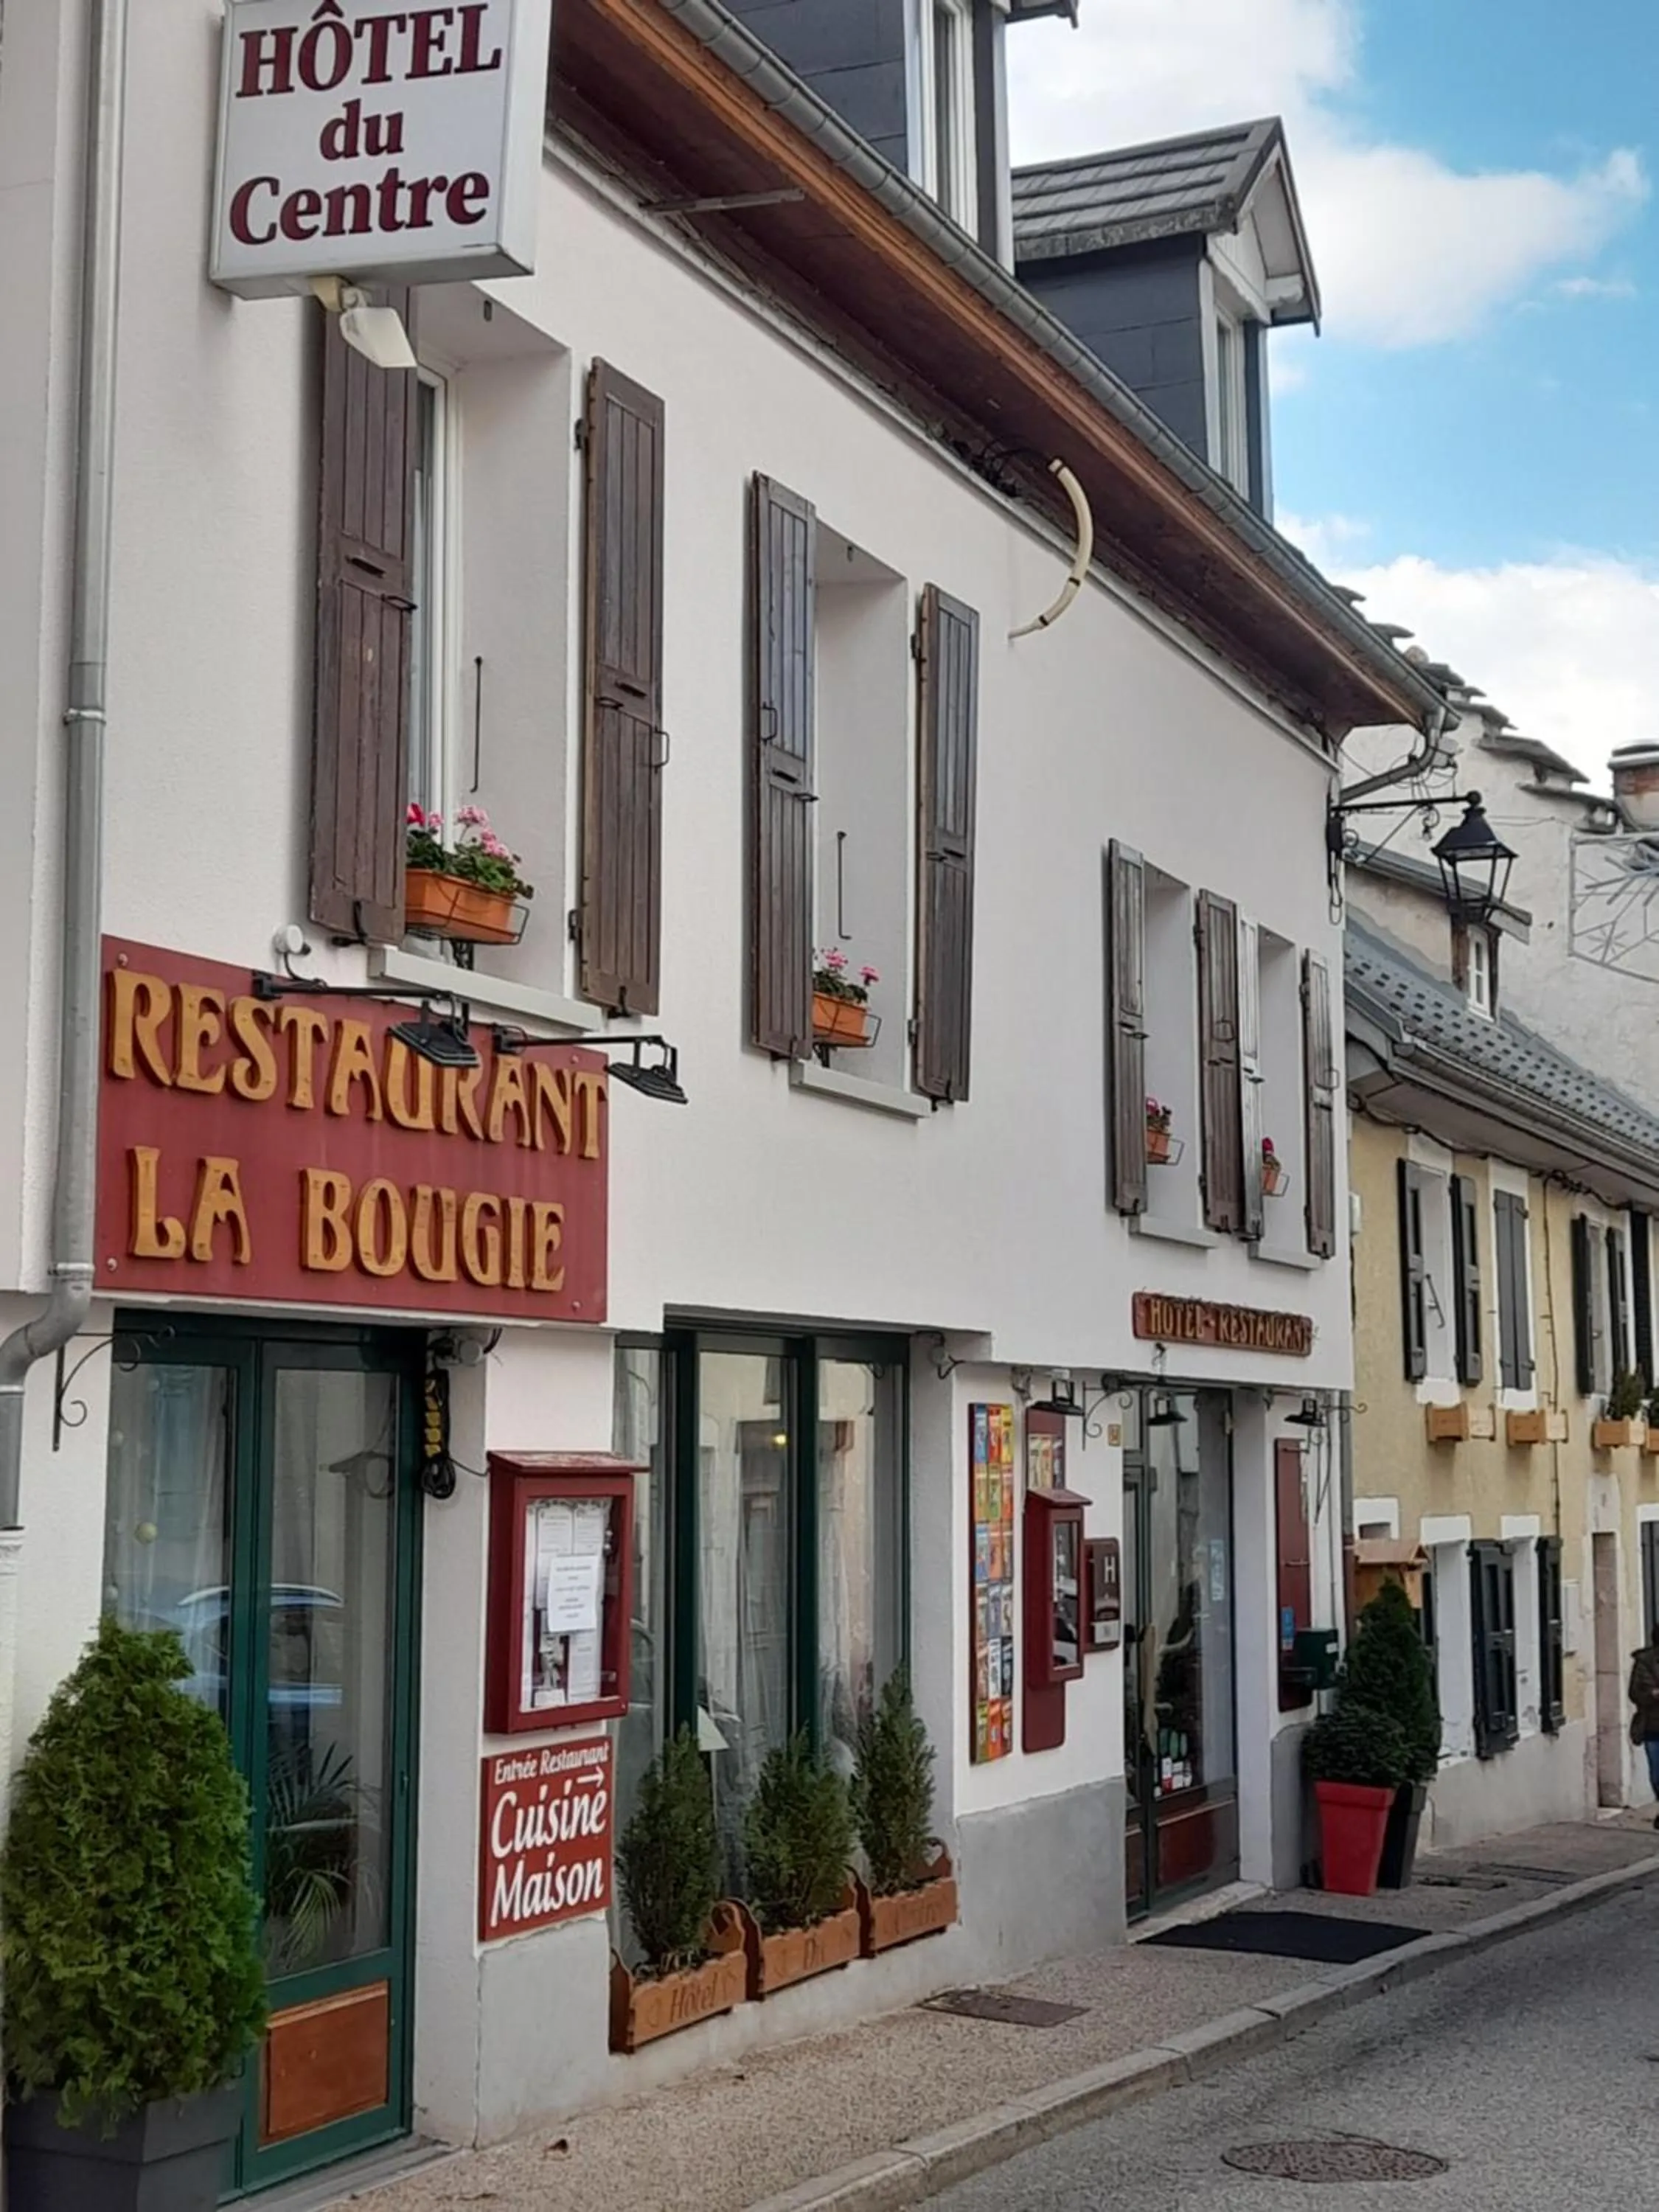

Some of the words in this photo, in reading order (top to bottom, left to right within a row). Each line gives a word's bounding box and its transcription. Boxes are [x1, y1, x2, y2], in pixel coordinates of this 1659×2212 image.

[236, 0, 502, 98] HÔTEL
[319, 98, 404, 161] du
[229, 167, 490, 245] Centre
[108, 969, 607, 1160] RESTAURANT
[128, 1145, 251, 1265] LA
[301, 1167, 566, 1292] BOUGIE
[1104, 1556, 1116, 1584] H
[495, 1753, 538, 1785] Entrée
[540, 1741, 610, 1775] Restaurant
[491, 1778, 607, 1859] Cuisine
[490, 1851, 605, 1928] Maison
